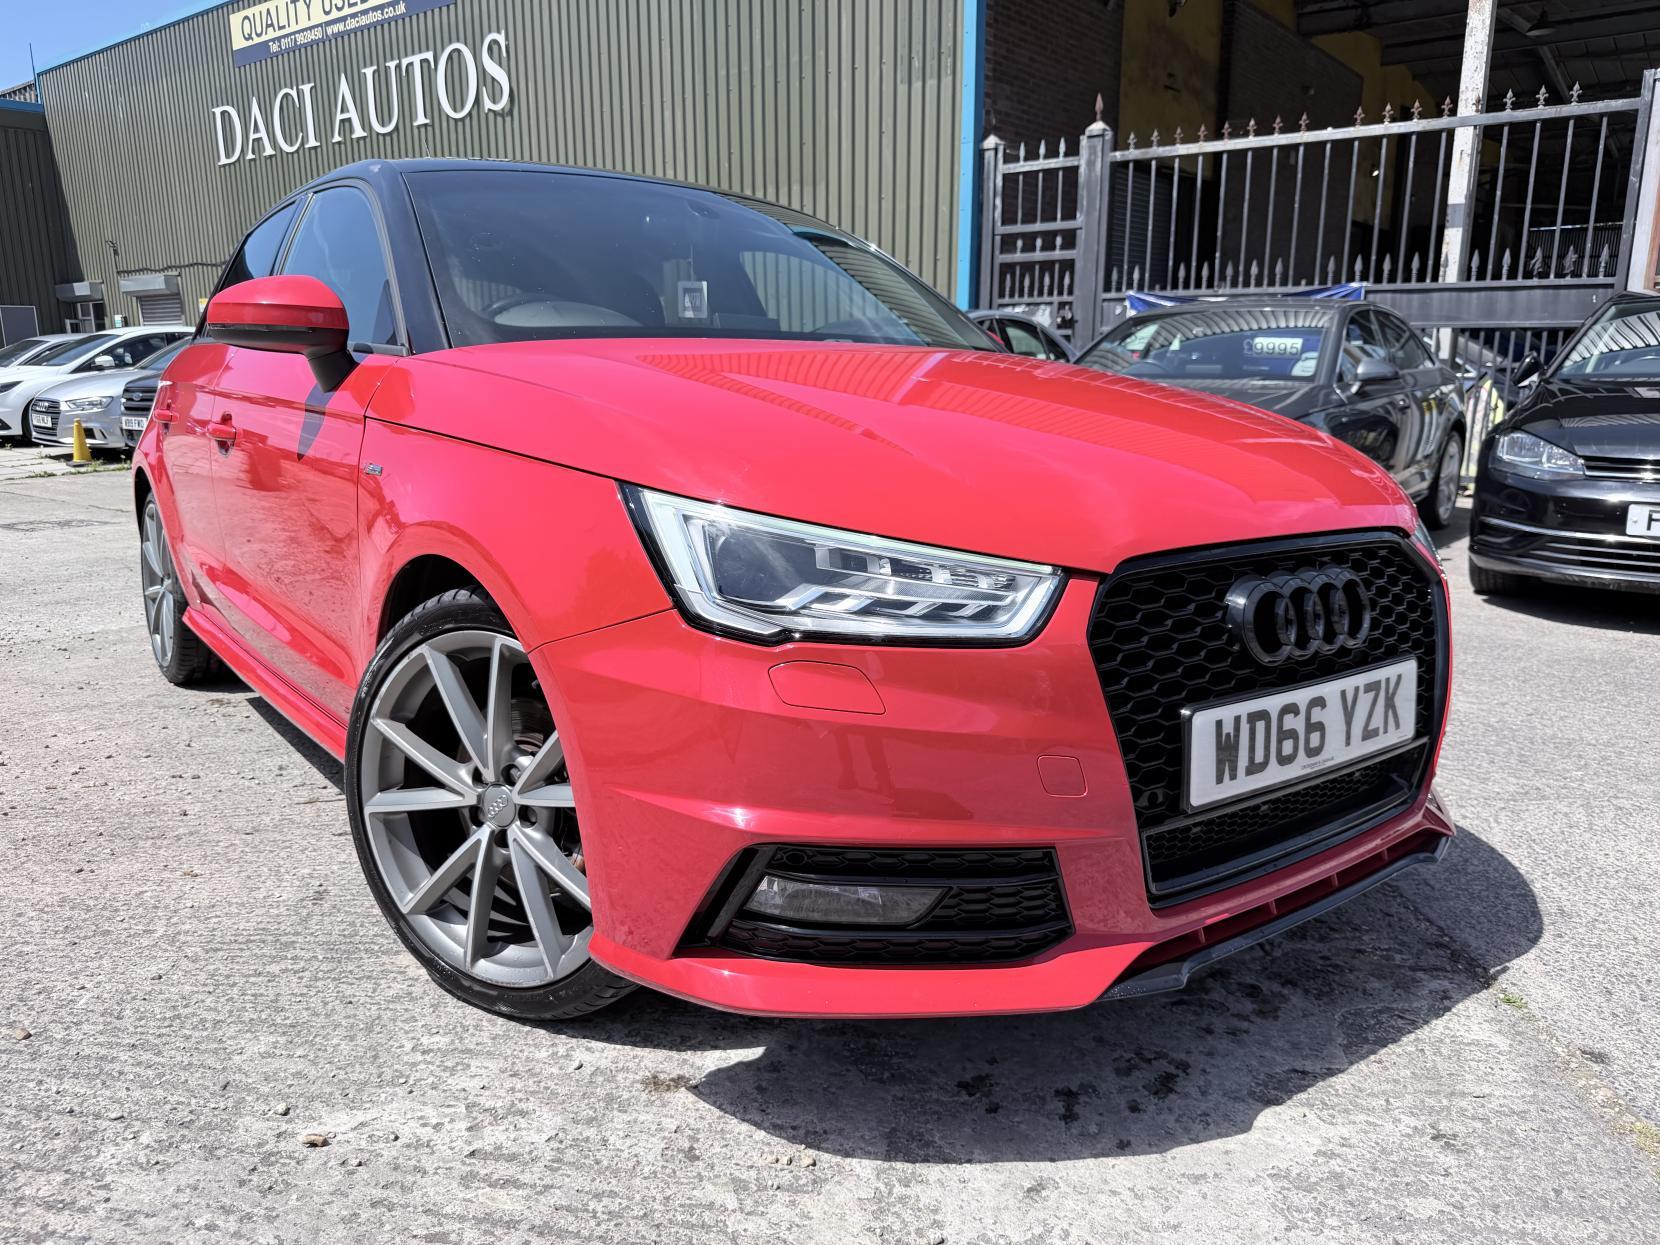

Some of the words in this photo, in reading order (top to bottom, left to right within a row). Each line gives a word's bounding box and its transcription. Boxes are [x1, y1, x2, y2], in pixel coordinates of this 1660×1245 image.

[241, 0, 312, 41] QUALITY
[322, 0, 369, 16] US
[268, 42, 280, 53] Tel:
[281, 36, 295, 50] 0117
[326, 3, 406, 35] www.daciautos.co.uk
[211, 83, 320, 166] DACI
[331, 30, 511, 143] AUTOS
[1215, 695, 1328, 786] WD66
[1340, 674, 1402, 747] YZK
